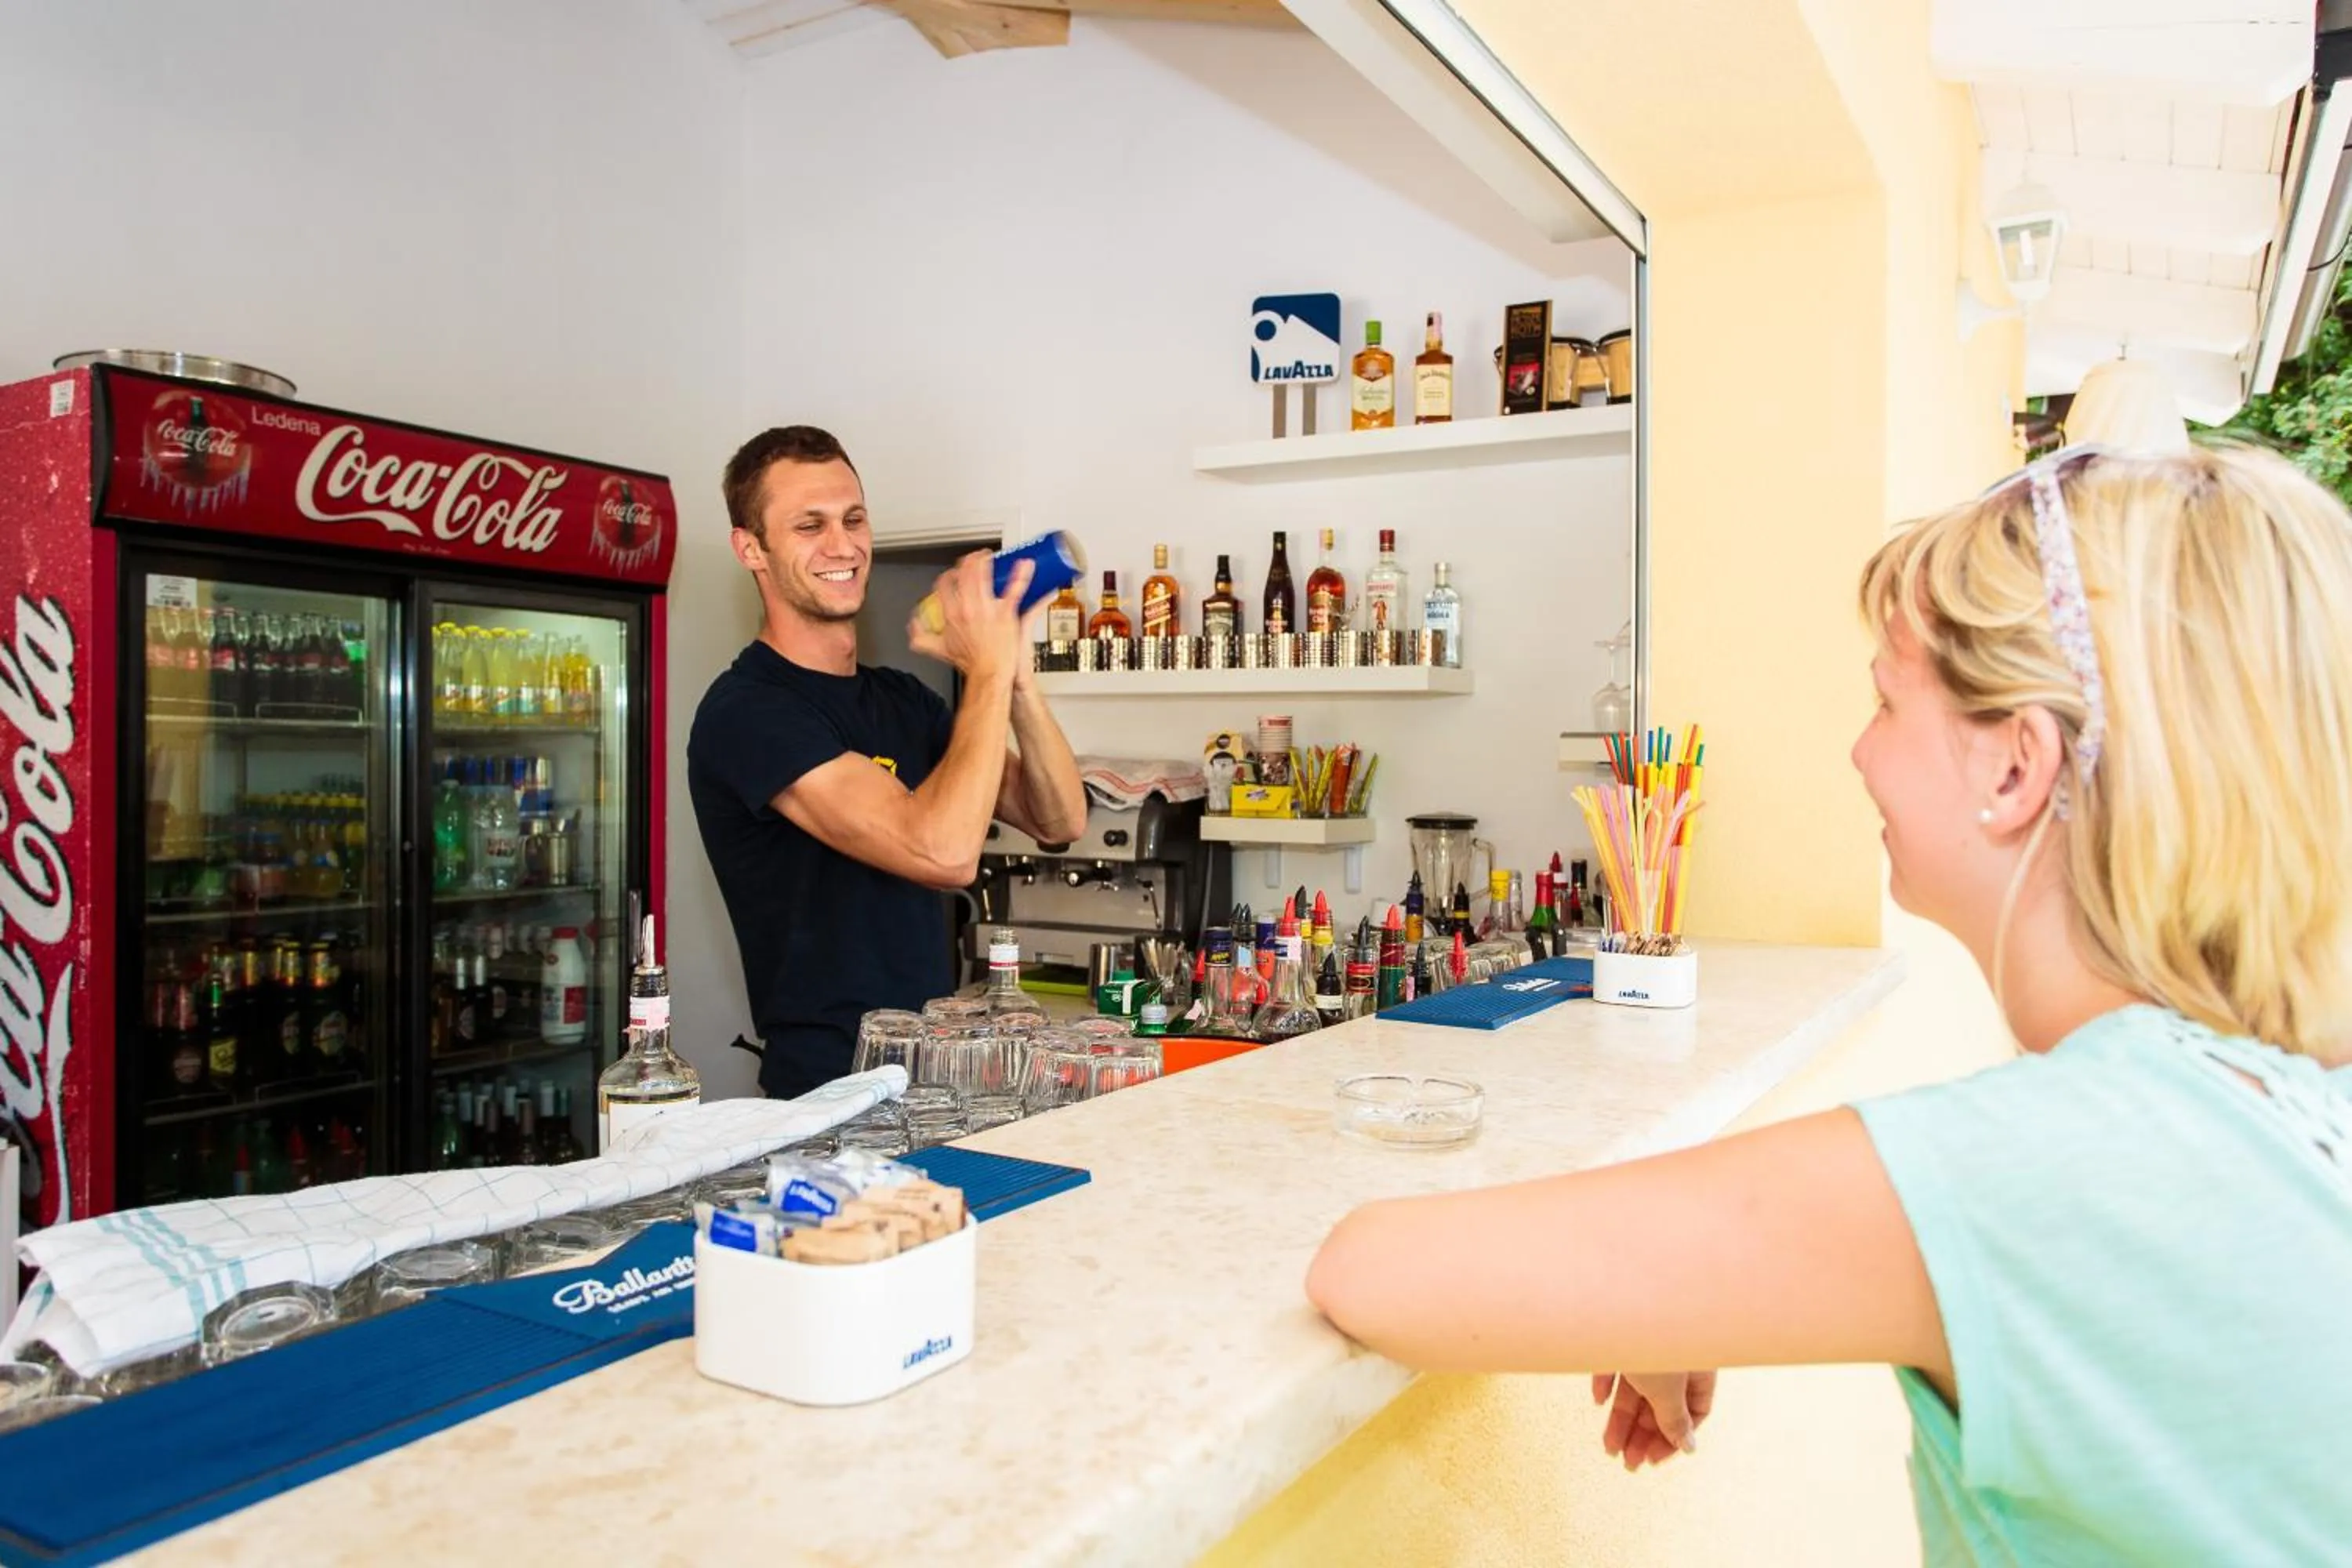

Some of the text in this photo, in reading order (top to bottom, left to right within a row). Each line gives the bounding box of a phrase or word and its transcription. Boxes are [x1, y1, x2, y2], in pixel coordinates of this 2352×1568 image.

[1264, 360, 1334, 379] LAVAZZA
[252, 406, 321, 436] Ledena
[296, 425, 568, 553] Coca-Cola
